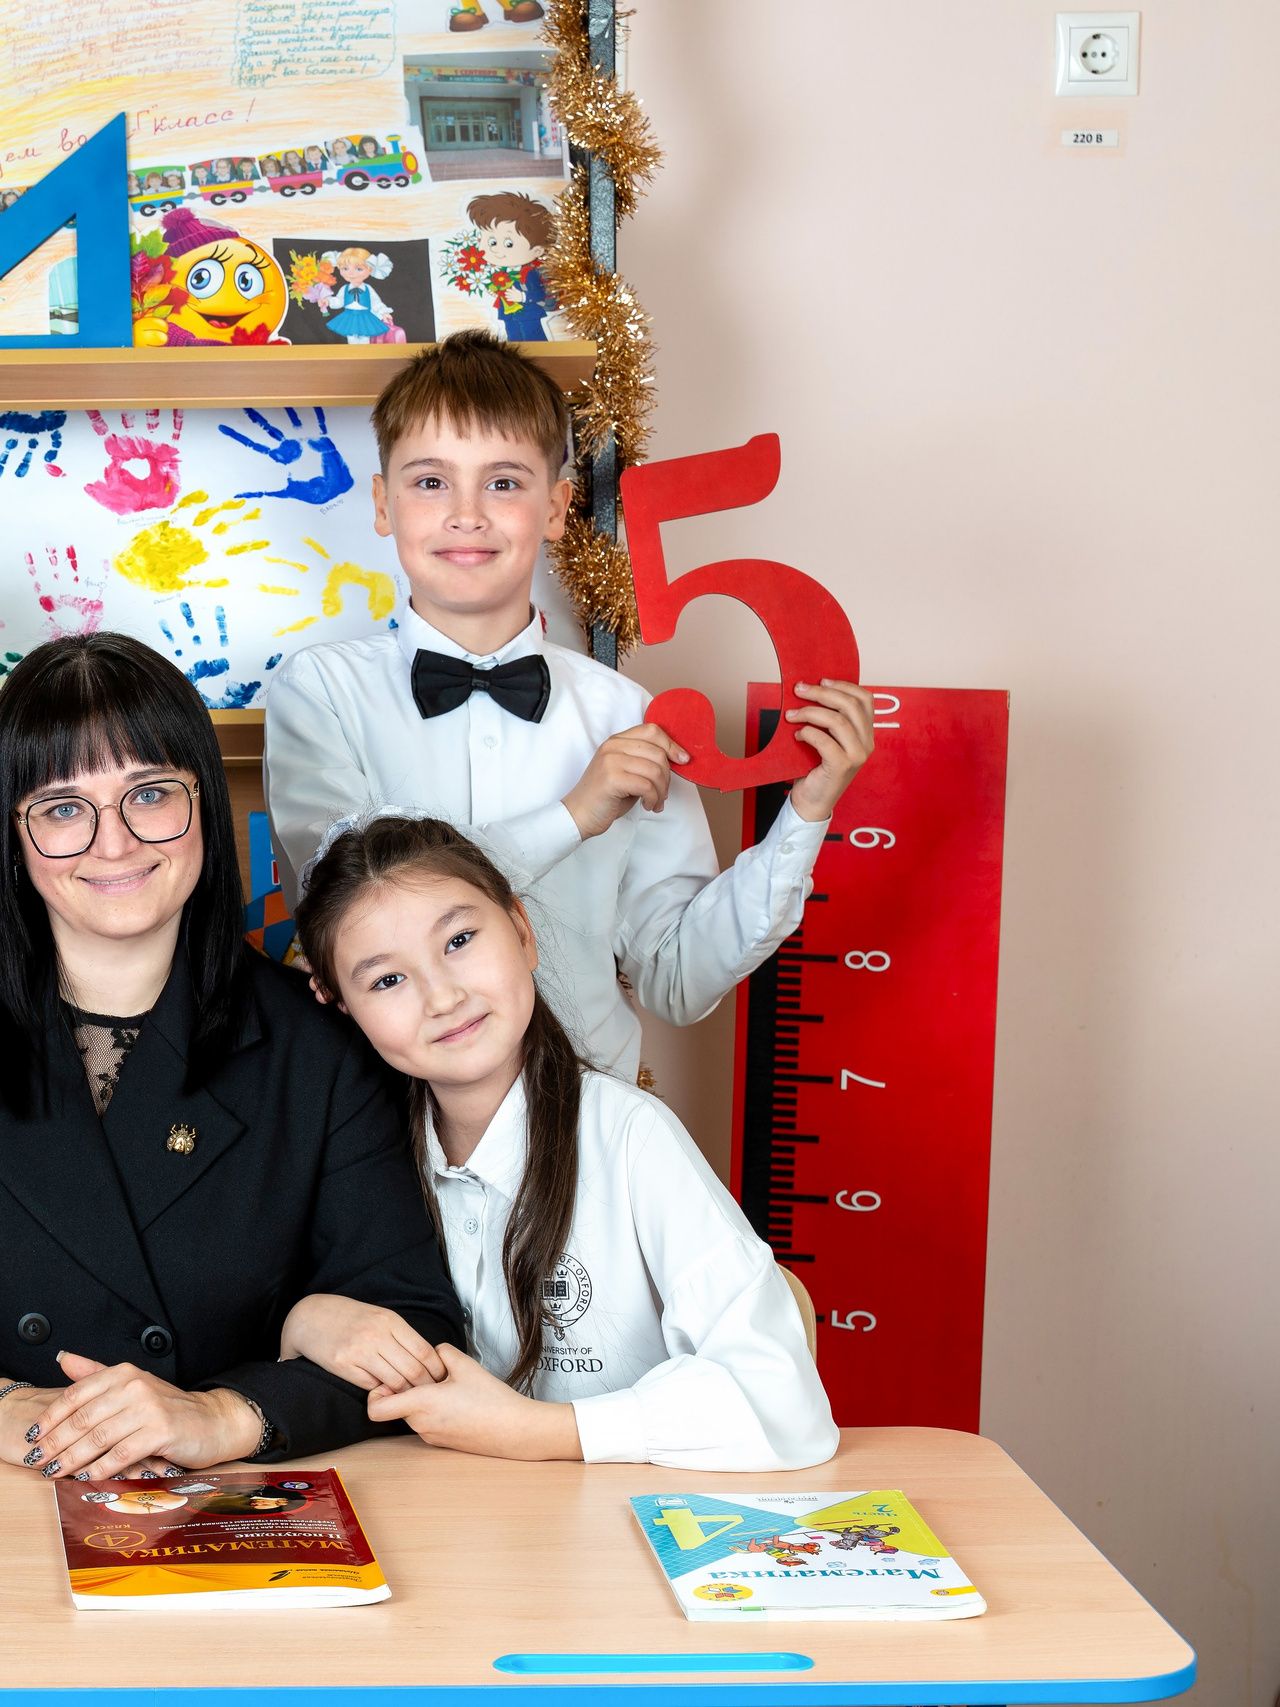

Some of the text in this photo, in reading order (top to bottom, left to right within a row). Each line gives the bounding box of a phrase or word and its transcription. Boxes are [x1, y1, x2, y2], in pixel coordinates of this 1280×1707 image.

[1073, 133, 1093, 143] 220
[620, 432, 860, 793] 5
[849, 827, 896, 849] 9
[844, 950, 891, 972] 8
[840, 1069, 886, 1090] 7
[835, 1189, 881, 1212] 6
[575, 1267, 590, 1312] OXFORD
[831, 1309, 877, 1332] 5
[581, 1346, 593, 1354] OF
[871, 1504, 894, 1512] 2
[235, 1533, 324, 1541] полугодие
[652, 1508, 745, 1551] 4
[101, 1534, 130, 1547] 4
[119, 1539, 347, 1560] МАТЕМАТИКА
[706, 1567, 944, 1580] Математика
